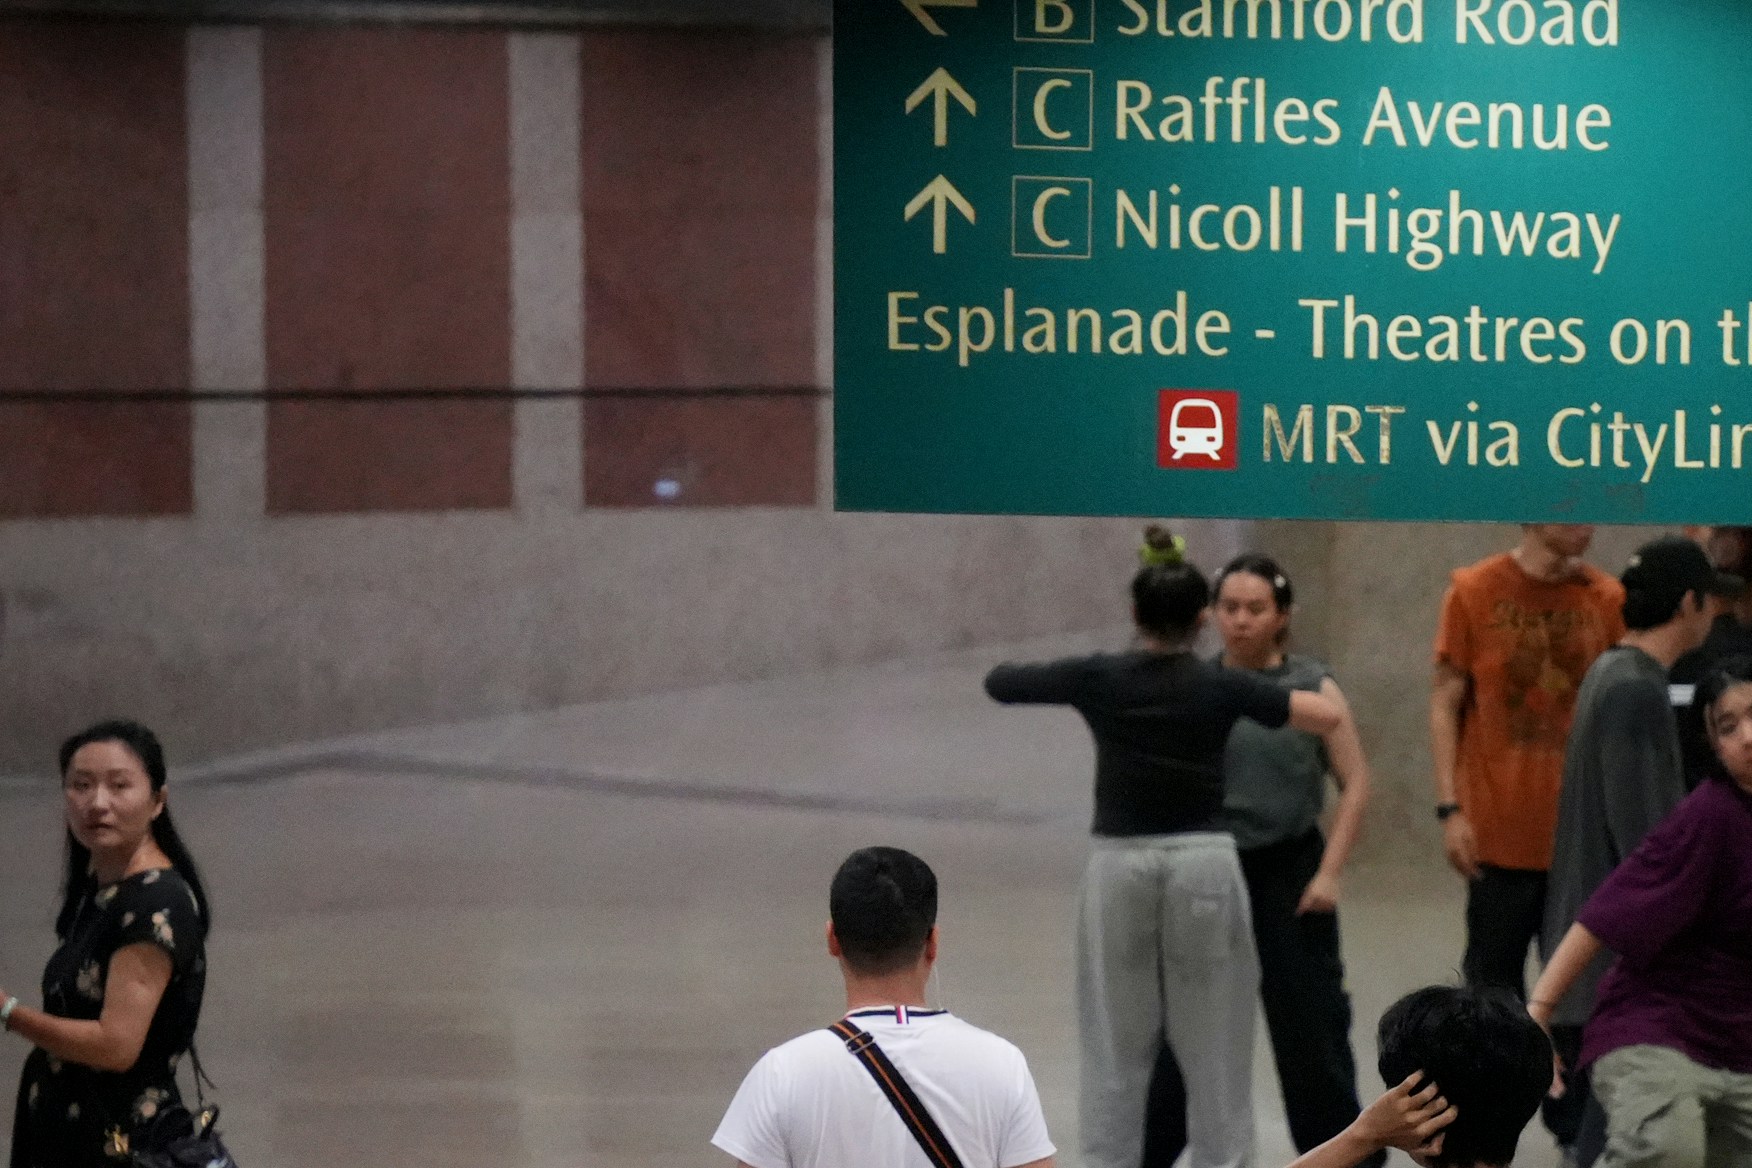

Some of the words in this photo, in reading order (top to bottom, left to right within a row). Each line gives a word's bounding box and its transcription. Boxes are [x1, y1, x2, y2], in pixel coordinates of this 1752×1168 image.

[1118, 0, 1425, 45] Stamford
[1453, 0, 1620, 48] Road
[1033, 78, 1072, 140] C
[1115, 75, 1343, 147] Raffles
[1361, 85, 1613, 152] Avenue
[1032, 186, 1071, 248] C
[1116, 183, 1304, 253] Nicoll
[1334, 186, 1622, 275] Highway
[888, 287, 1232, 367] Esplanade
[1297, 294, 1588, 365] Theatres
[1609, 317, 1692, 366] on
[1261, 403, 1406, 466] MRT
[1425, 400, 1520, 468] via
